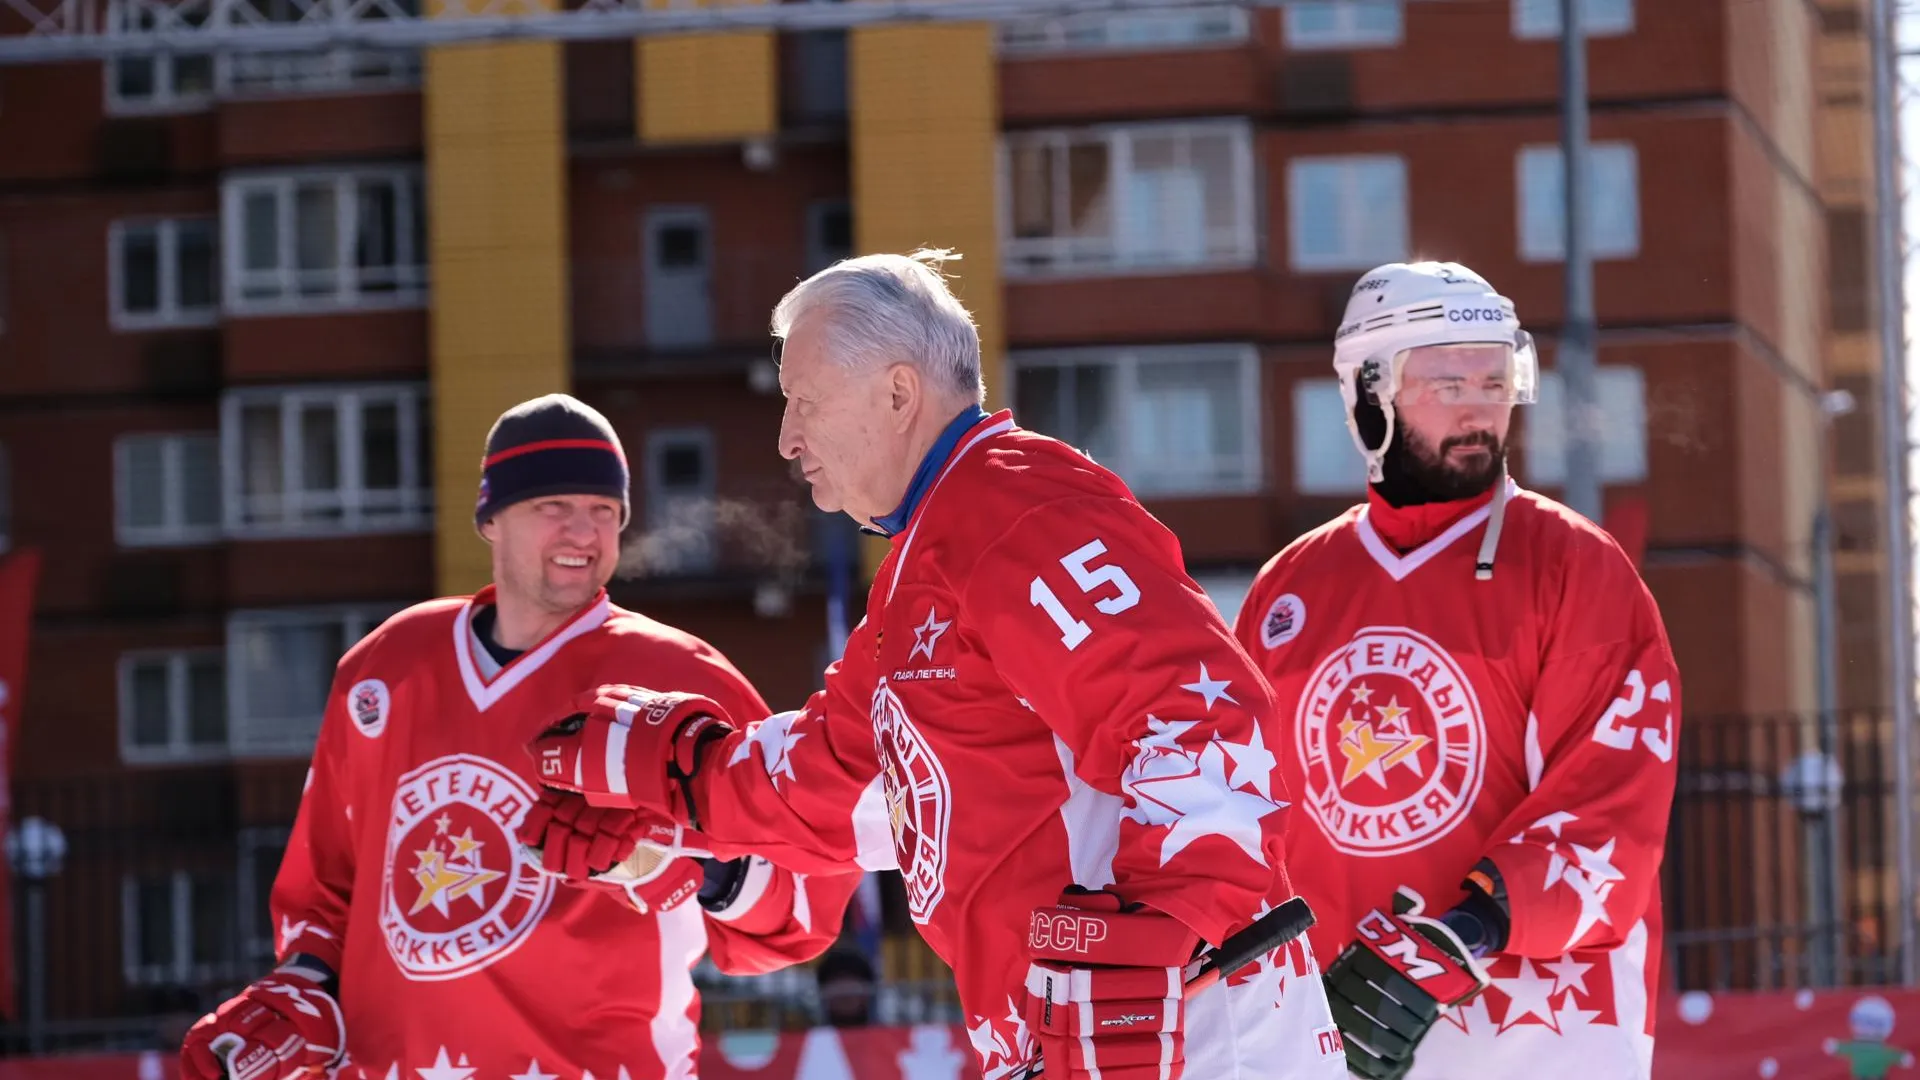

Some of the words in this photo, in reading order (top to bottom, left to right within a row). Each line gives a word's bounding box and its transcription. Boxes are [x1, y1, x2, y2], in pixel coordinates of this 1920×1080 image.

[1449, 308, 1503, 322] согаз
[1030, 538, 1141, 652] 15
[893, 670, 914, 680] ПАРК
[915, 668, 956, 680] ЛЕГЕНД
[1592, 669, 1673, 763] 23
[543, 746, 562, 775] 15
[396, 770, 522, 827] ЕГЕНД
